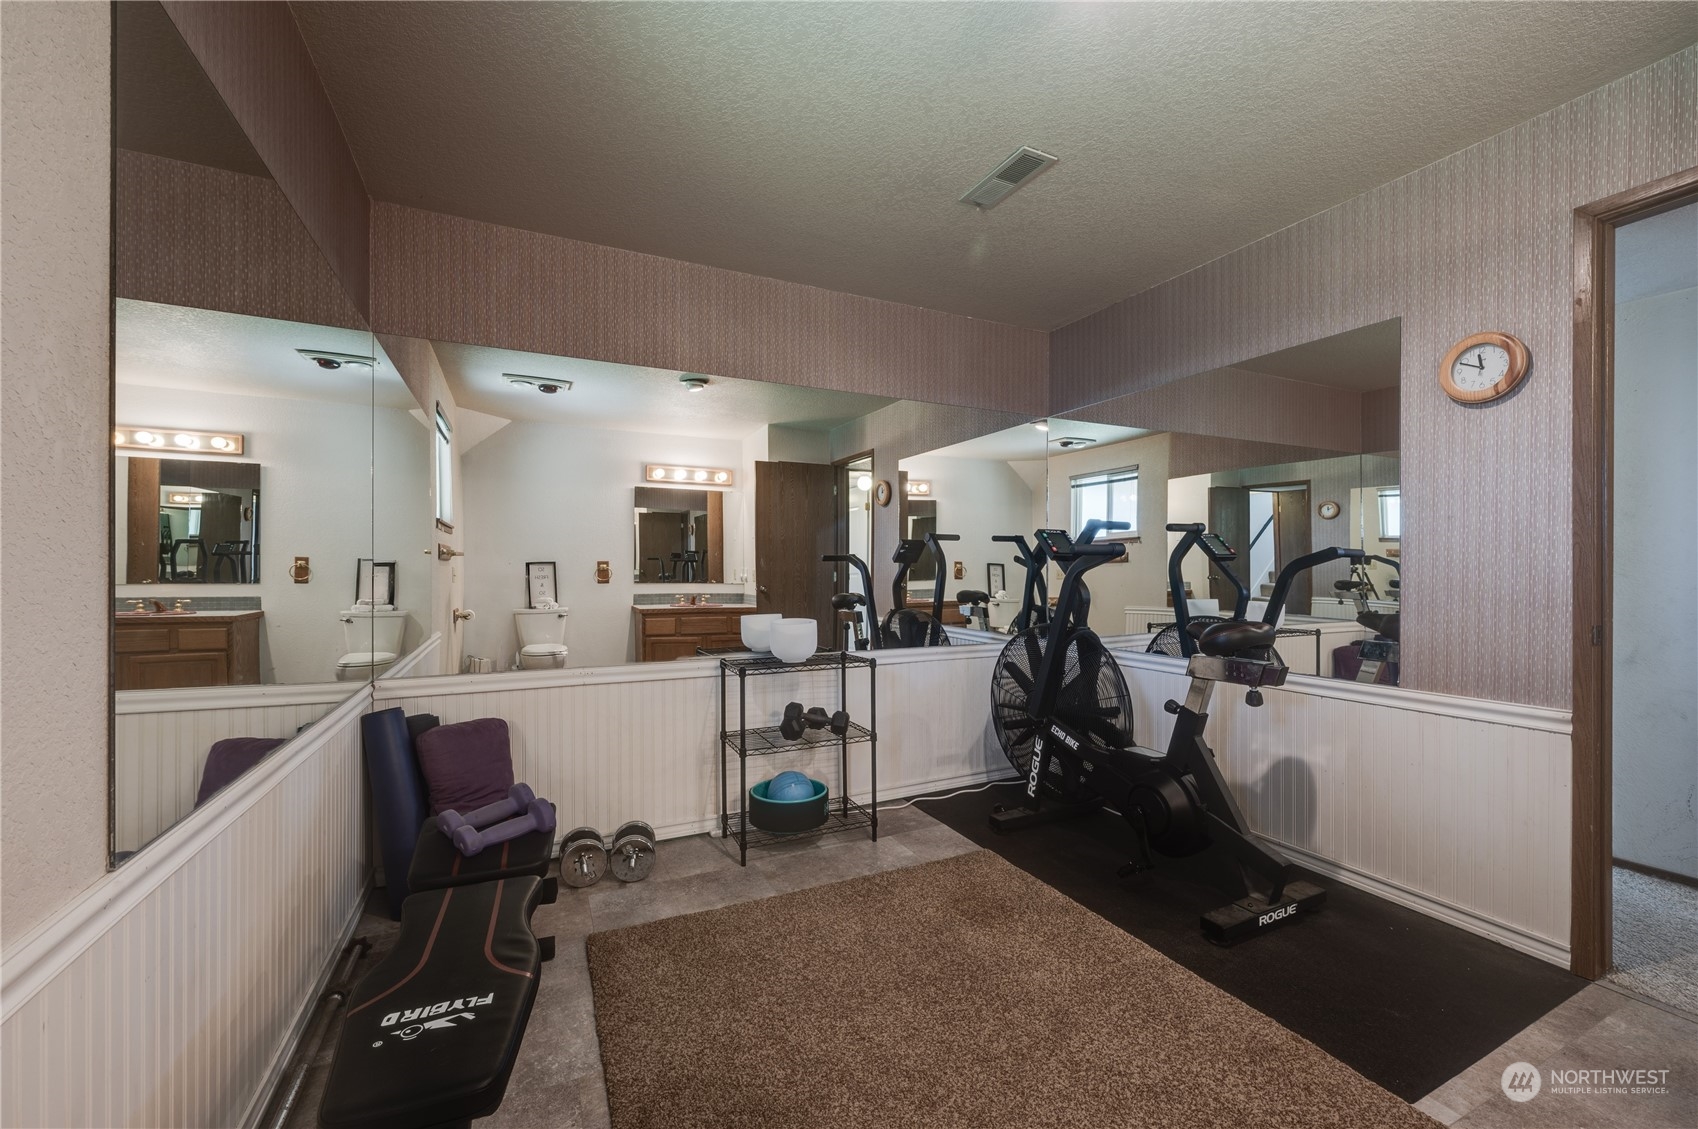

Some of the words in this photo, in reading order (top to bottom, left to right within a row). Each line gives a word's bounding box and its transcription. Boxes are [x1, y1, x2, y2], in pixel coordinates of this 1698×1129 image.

[1050, 724, 1066, 741] ECHO
[1065, 735, 1080, 751] BIKE
[1027, 736, 1043, 798] ROGUE
[1258, 903, 1298, 927] ROGUE
[380, 992, 494, 1027] FLYBIRD
